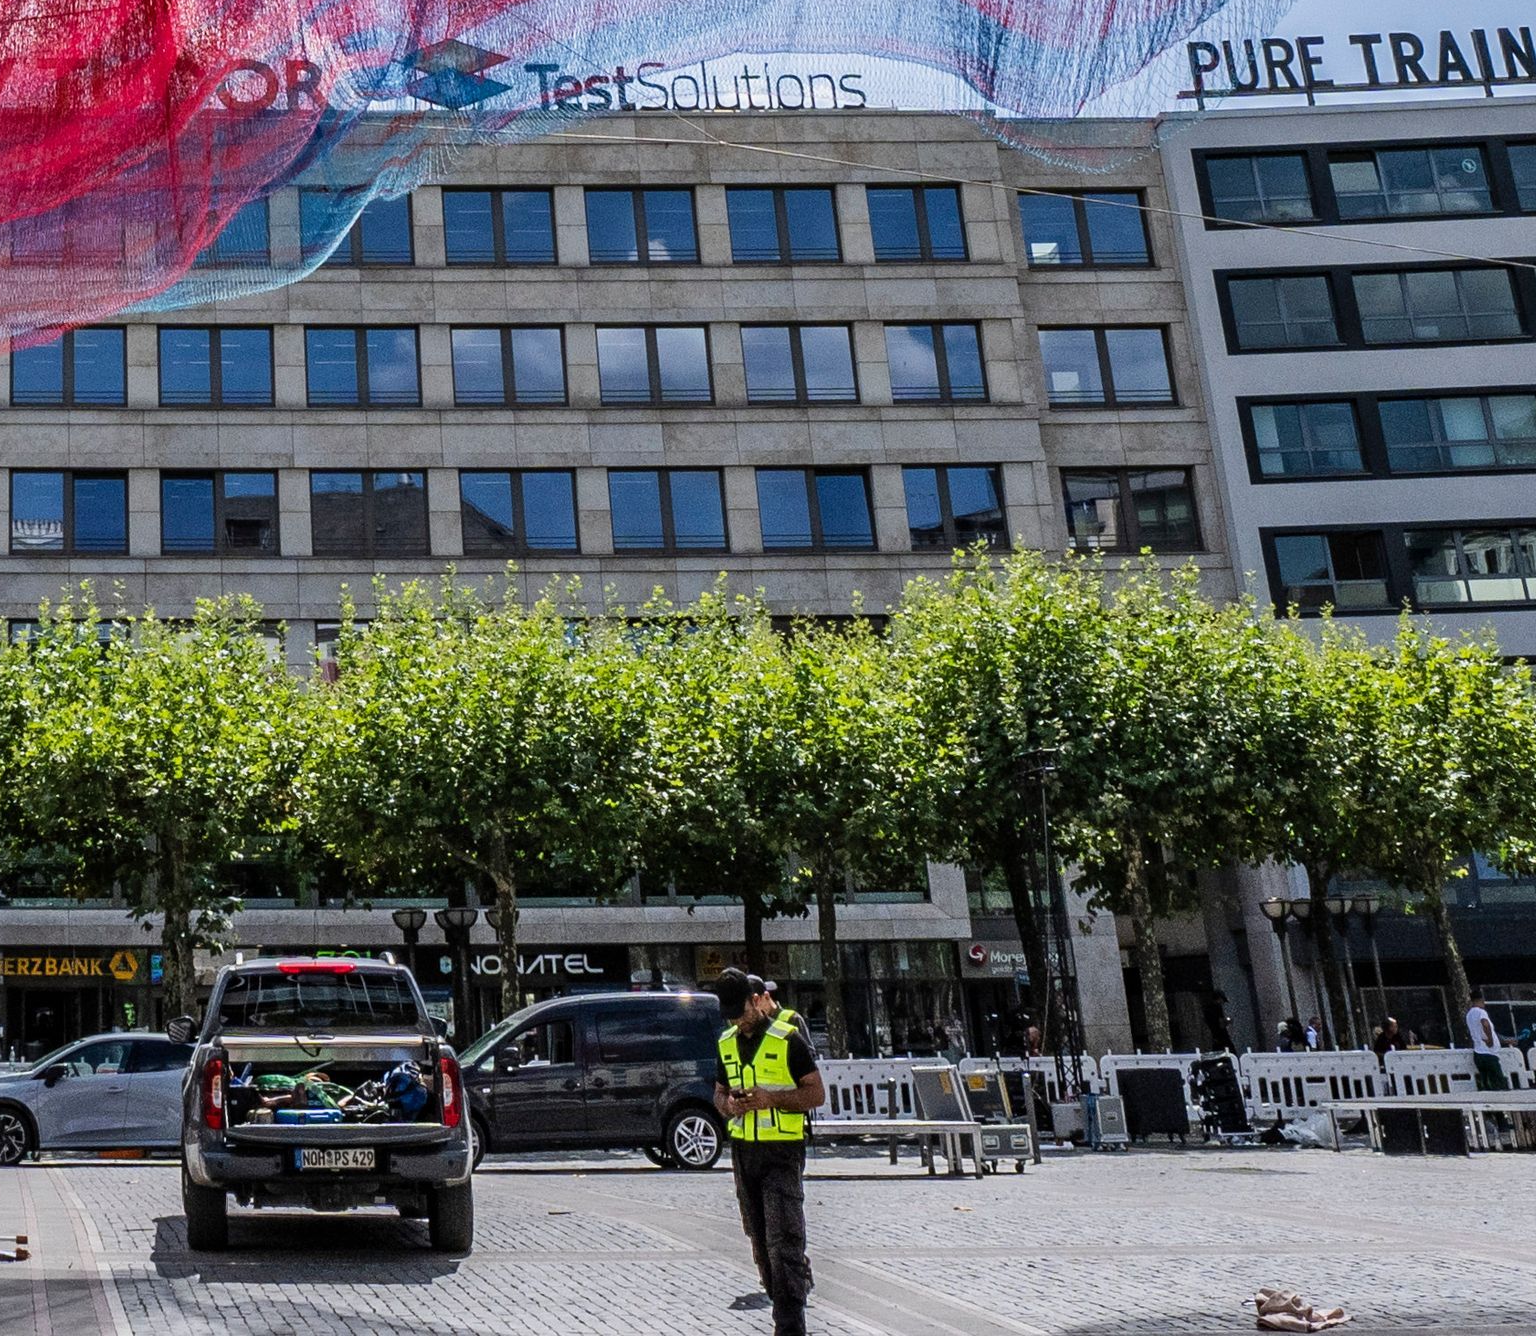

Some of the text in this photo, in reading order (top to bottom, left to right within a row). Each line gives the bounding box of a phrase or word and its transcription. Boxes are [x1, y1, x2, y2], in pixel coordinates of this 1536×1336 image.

[524, 61, 867, 111] TestSolutions
[1188, 35, 1334, 91] PURE
[302, 1150, 374, 1166] NOH PS 429
